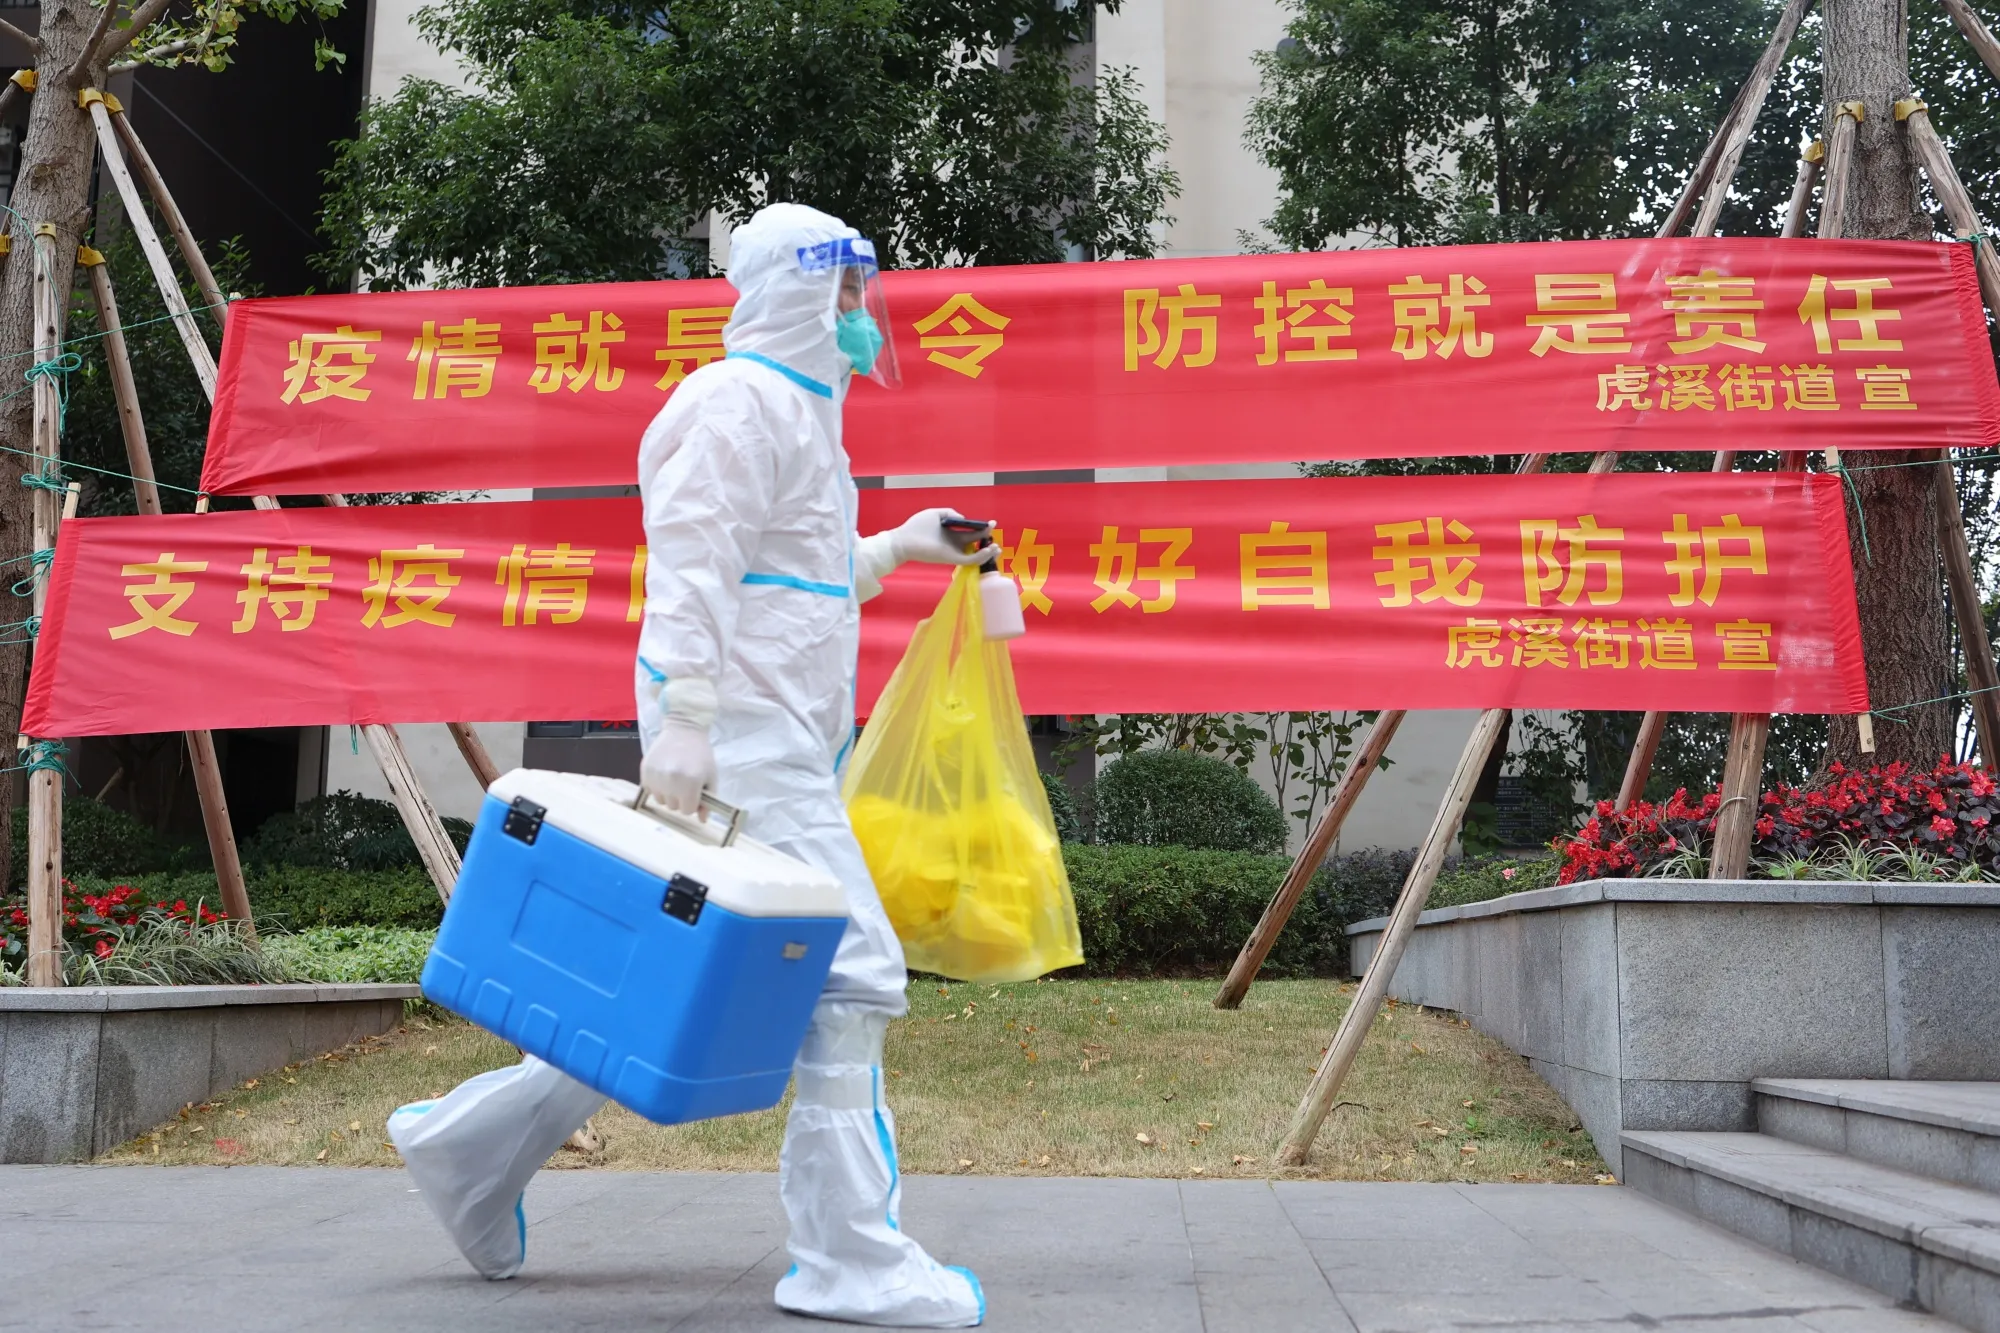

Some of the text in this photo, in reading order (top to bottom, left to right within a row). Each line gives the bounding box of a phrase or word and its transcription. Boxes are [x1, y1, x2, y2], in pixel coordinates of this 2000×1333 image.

[280, 269, 1904, 405] 疫情就是令 防控就是责任
[1595, 363, 1918, 412] 虎溪街道 宣
[108, 543, 648, 640] 支持疫情
[1444, 617, 1777, 670] 虎溪街道 宣
